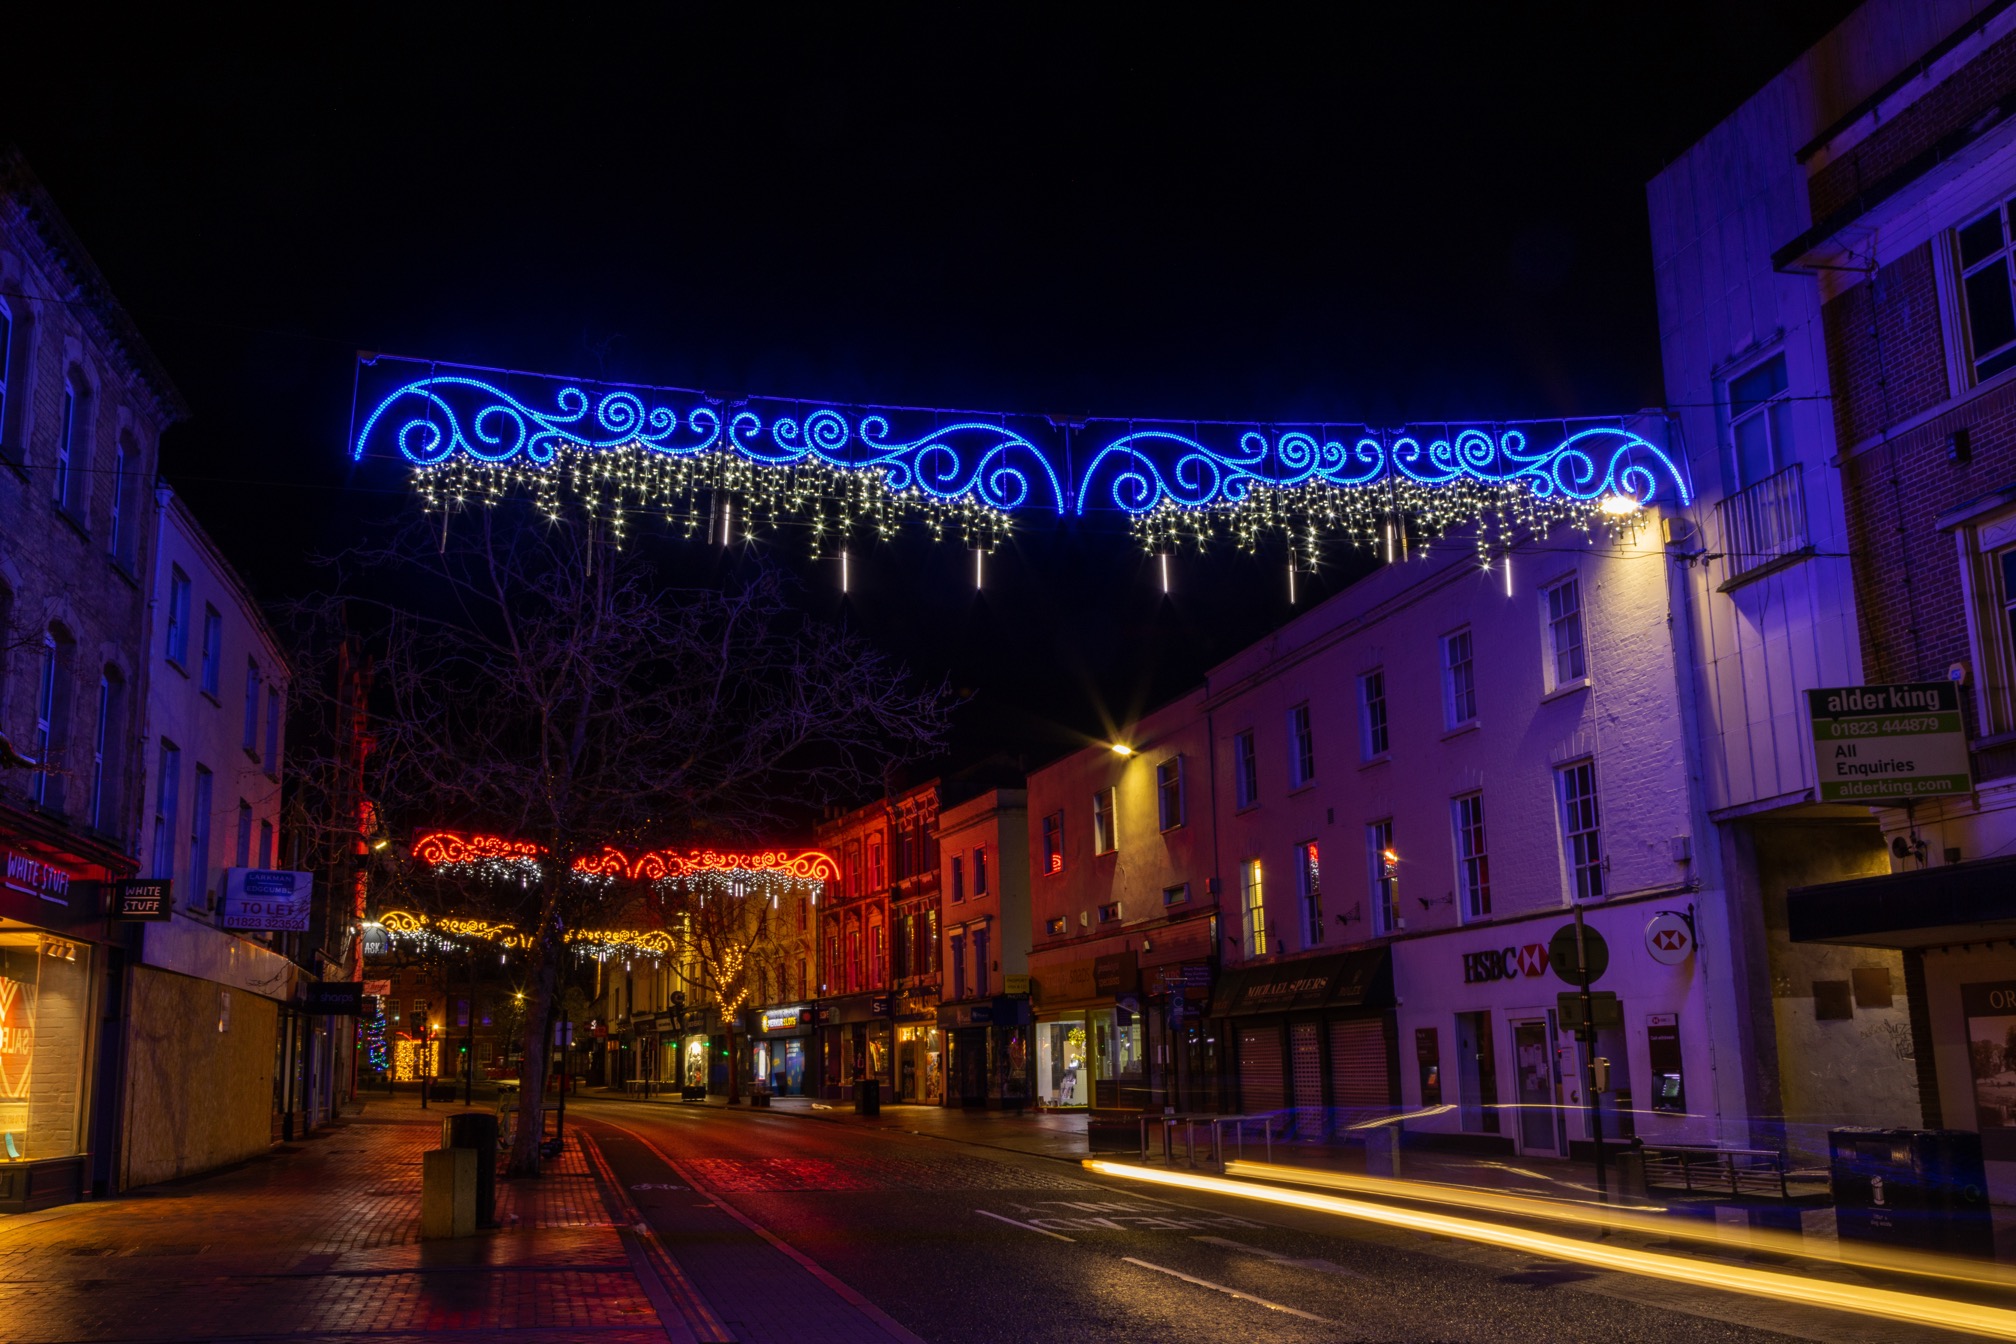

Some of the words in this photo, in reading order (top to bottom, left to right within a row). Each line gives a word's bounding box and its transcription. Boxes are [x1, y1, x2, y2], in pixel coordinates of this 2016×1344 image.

[1827, 689, 1886, 712] alder
[1889, 686, 1941, 711] king
[1831, 721, 1878, 737] 01823
[1882, 717, 1939, 732] 444879
[1835, 744, 1857, 758] All
[1836, 759, 1915, 776] Enquiries
[1840, 779, 1952, 796] alderking.com
[6, 851, 40, 887] WHITE
[41, 864, 70, 896] STUFF
[248, 874, 292, 882] LARKMAN
[124, 885, 162, 896] WHITE
[122, 900, 160, 911] STUFF
[241, 902, 262, 914] TO
[266, 904, 294, 916] LET
[227, 917, 262, 927] 01823
[364, 942, 380, 954] ASK
[1463, 946, 1518, 984] HSBC
[1247, 981, 1288, 997] MICHAEL
[1288, 976, 1329, 992] SPIERS
[319, 991, 353, 1004] sharps
